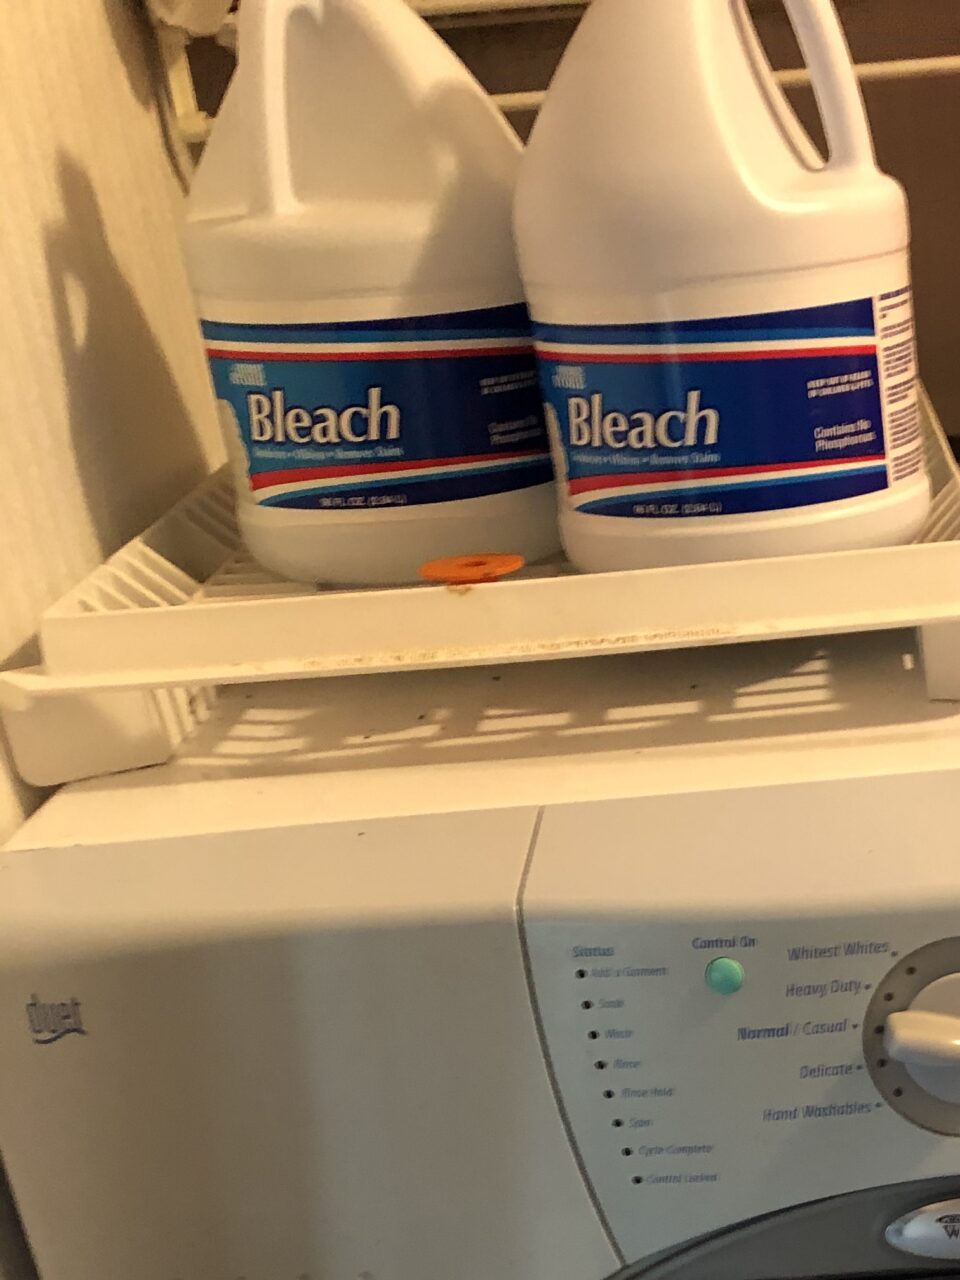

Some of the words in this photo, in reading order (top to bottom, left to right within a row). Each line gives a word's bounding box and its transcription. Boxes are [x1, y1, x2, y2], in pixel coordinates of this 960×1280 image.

[247, 386, 401, 444] Bleach
[567, 390, 720, 449] Bleach
[691, 938, 737, 950] Control
[739, 935, 757, 949] On
[787, 945, 839, 961] Whitest
[843, 940, 890, 957] Whites
[785, 983, 827, 1000] Heavy
[830, 979, 862, 996] Duty
[737, 1023, 791, 1041] Normal
[802, 1018, 849, 1036] Casual
[800, 1064, 854, 1080] Delicate
[762, 1106, 799, 1122] Hand
[801, 1100, 873, 1119] Washables
